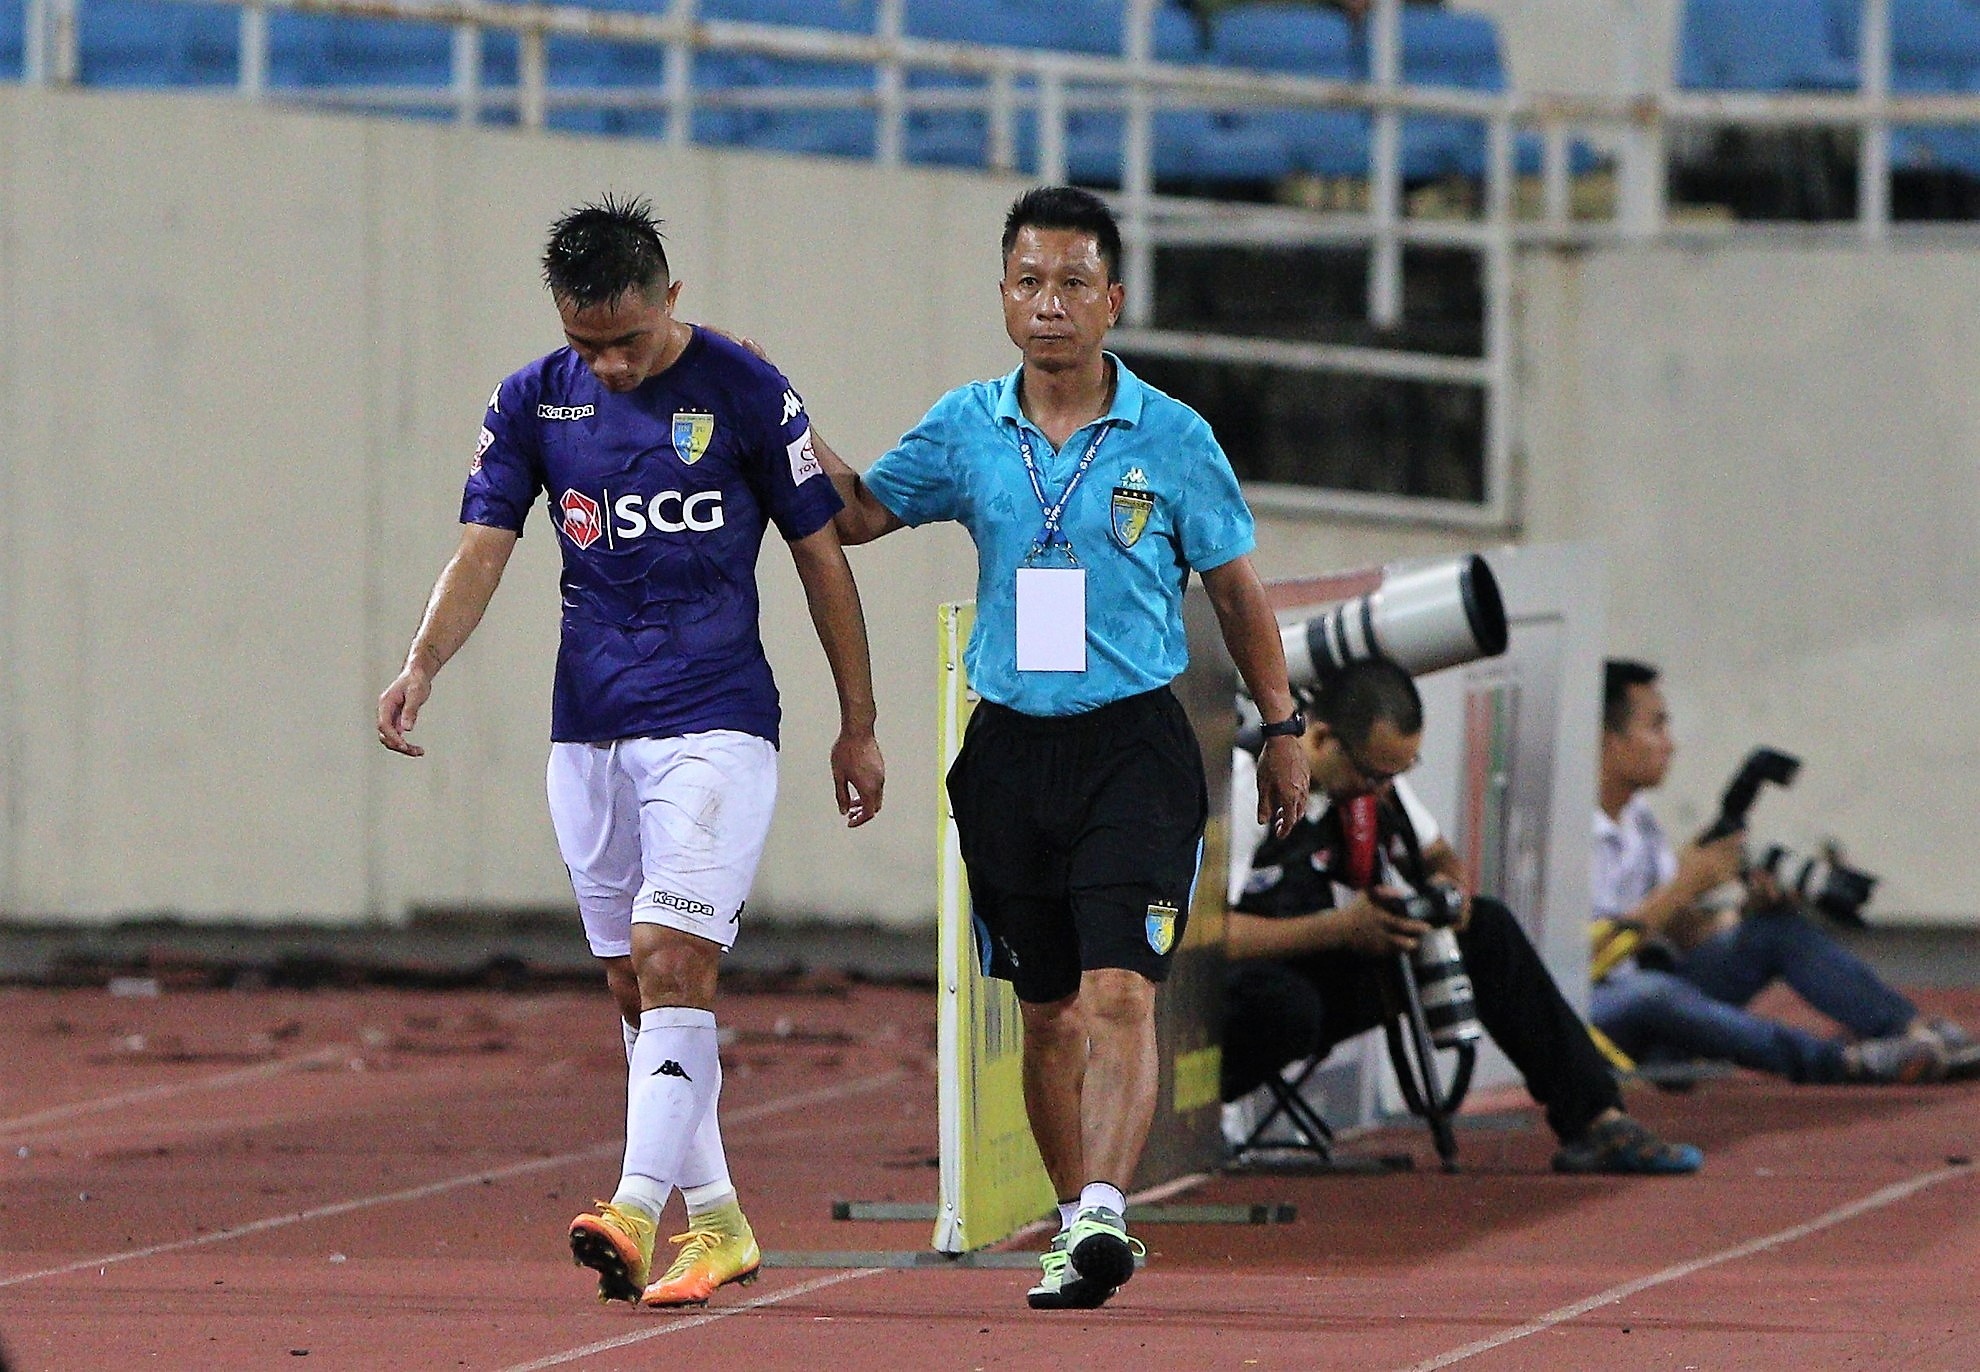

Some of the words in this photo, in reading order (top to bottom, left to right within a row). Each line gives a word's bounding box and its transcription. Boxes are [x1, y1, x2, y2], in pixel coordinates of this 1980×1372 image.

[537, 404, 595, 420] Kappa
[1022, 451, 1033, 469] VPF
[1083, 445, 1096, 462] VPF
[799, 462, 817, 475] TOY
[615, 489, 725, 538] SCG
[1049, 504, 1061, 521] VPF
[653, 891, 714, 916] Kappa
